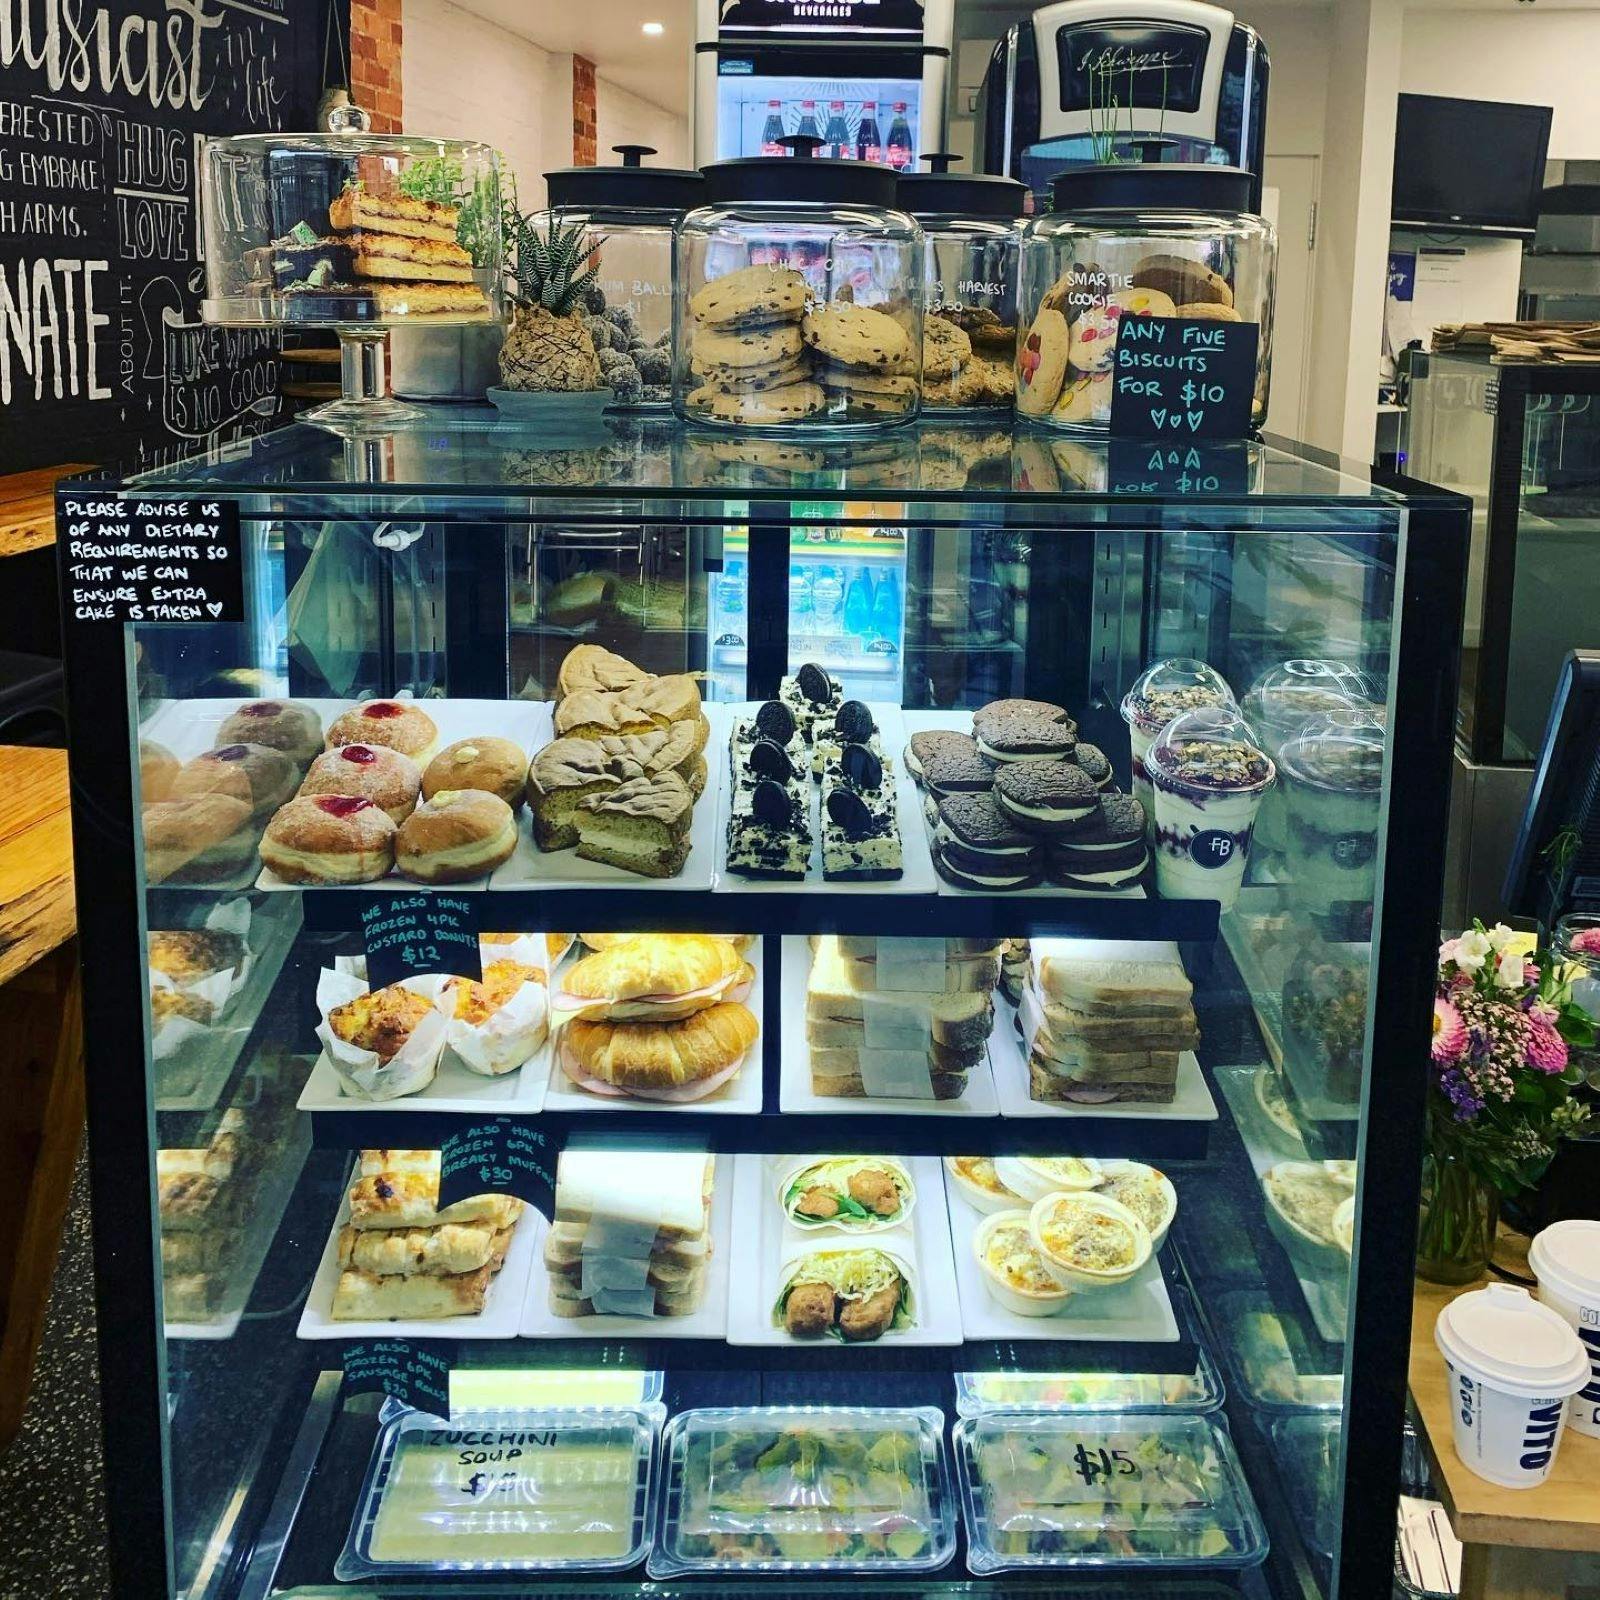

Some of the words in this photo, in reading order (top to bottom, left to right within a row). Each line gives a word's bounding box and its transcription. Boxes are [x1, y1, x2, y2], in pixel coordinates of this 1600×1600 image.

[793, 4, 852, 17] BEVERAGES
[117, 120, 188, 191] HUG
[20, 152, 99, 191] EMBRACE
[22, 202, 88, 238] ARMS.
[117, 197, 189, 261] LOVE
[120, 274, 133, 304] IT.
[957, 279, 1007, 296] HARVEST
[1066, 270, 1134, 290] SMARTIE
[1068, 292, 1116, 307] COOKIE
[1121, 321, 1166, 343] ANY
[1183, 327, 1226, 346] FIVE
[120, 313, 134, 394] ABOUT
[1119, 350, 1208, 373] BISCUITS
[171, 386, 188, 429] IS
[193, 385, 221, 431] NO
[230, 360, 277, 411] GOOD
[1118, 376, 1163, 397] FOR
[1180, 379, 1225, 408] $10
[65, 501, 128, 518] PLEASE
[136, 502, 189, 516] ADVISE
[202, 502, 220, 517] US
[69, 521, 91, 536] OF
[98, 524, 130, 537] ANY
[145, 524, 220, 538] DIETARY
[71, 541, 200, 559] REQUIREMENTS
[207, 546, 228, 560] SO
[70, 565, 114, 580] THAT
[122, 567, 148, 580] WE
[153, 567, 189, 580] CAN
[73, 588, 138, 602] ENSURE
[151, 587, 207, 601] EXTRA
[129, 605, 144, 620] IS
[146, 605, 202, 621] TAKEN
[1208, 837, 1231, 856] FB
[361, 904, 382, 922] WE
[390, 898, 427, 912] ALSO
[437, 898, 470, 914] HAVE
[364, 914, 417, 938] FROZEN
[427, 914, 459, 927] 4PK
[367, 929, 427, 953] CUSTARD
[434, 930, 477, 949] DONUTS
[402, 944, 440, 965] $12
[467, 1125, 500, 1139] ALSO
[511, 1126, 545, 1147] HAVE
[479, 1165, 513, 1183] $30
[344, 1355, 399, 1372] FROZEN
[373, 1343, 410, 1354] ALSO
[417, 1351, 448, 1373] HAVE
[348, 1368, 409, 1384] SAUSAGE
[429, 1431, 557, 1447] ZUCCHINI
[1519, 1401, 1564, 1471] VITO
[458, 1448, 523, 1465] SOUP
[1073, 1443, 1136, 1486] $15
